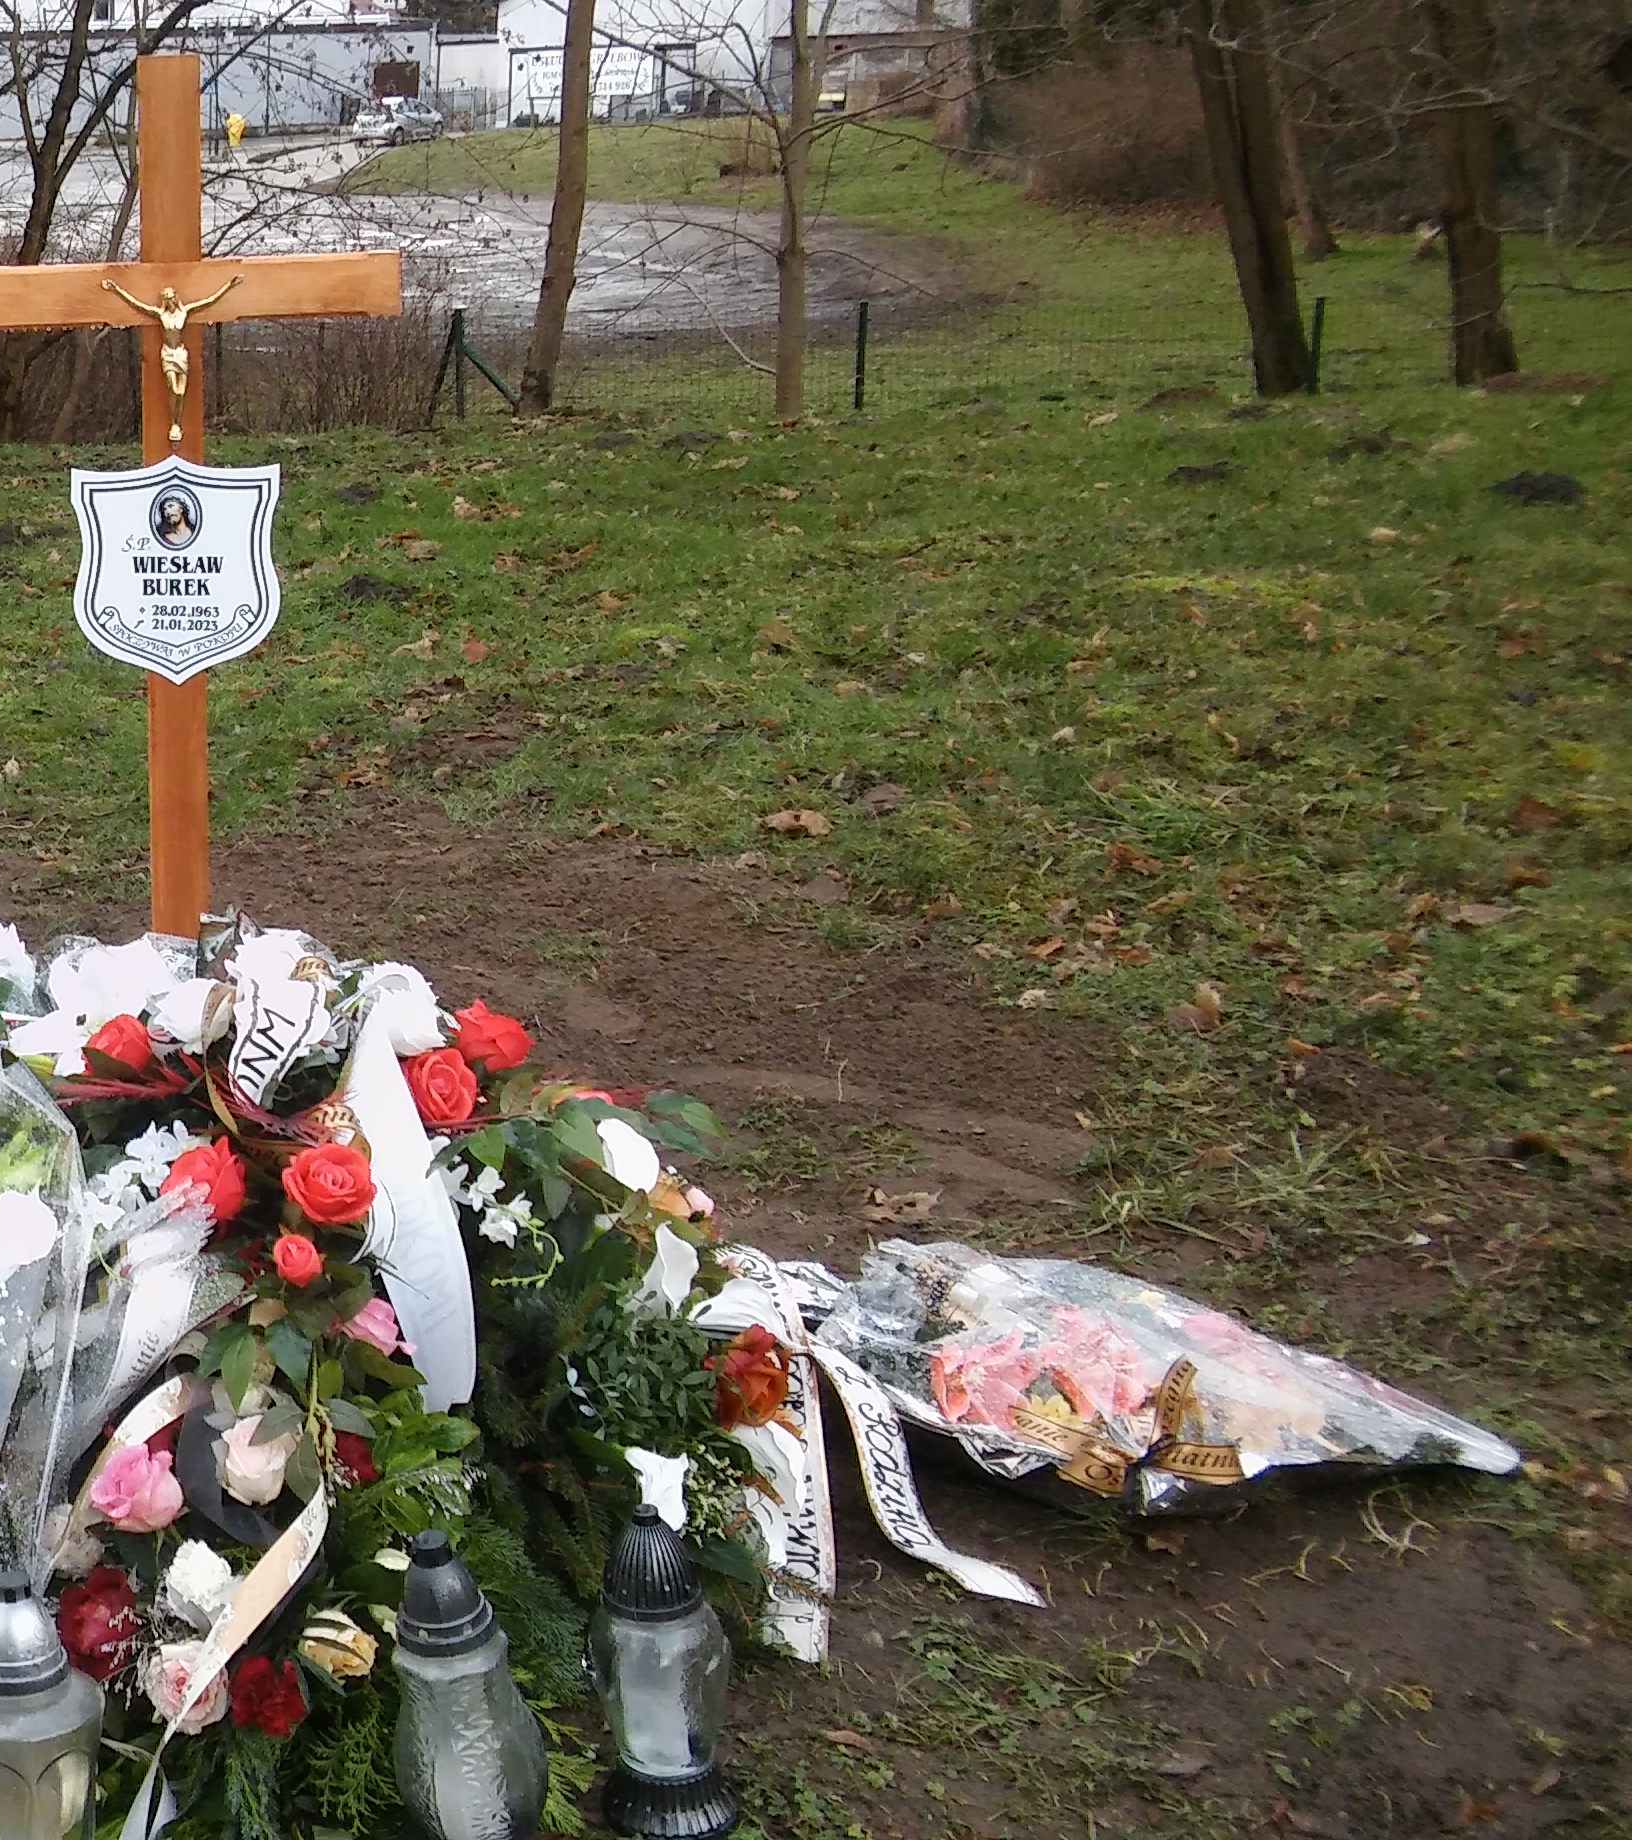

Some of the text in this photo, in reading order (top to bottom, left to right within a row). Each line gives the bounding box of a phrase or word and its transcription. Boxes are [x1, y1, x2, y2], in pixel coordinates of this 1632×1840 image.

[132, 556, 224, 574] WIESŁAW
[142, 578, 210, 596] BUREK
[151, 604, 220, 618] 28.02.1963
[151, 618, 218, 631] 21.01.2023
[178, 646, 192, 657] W
